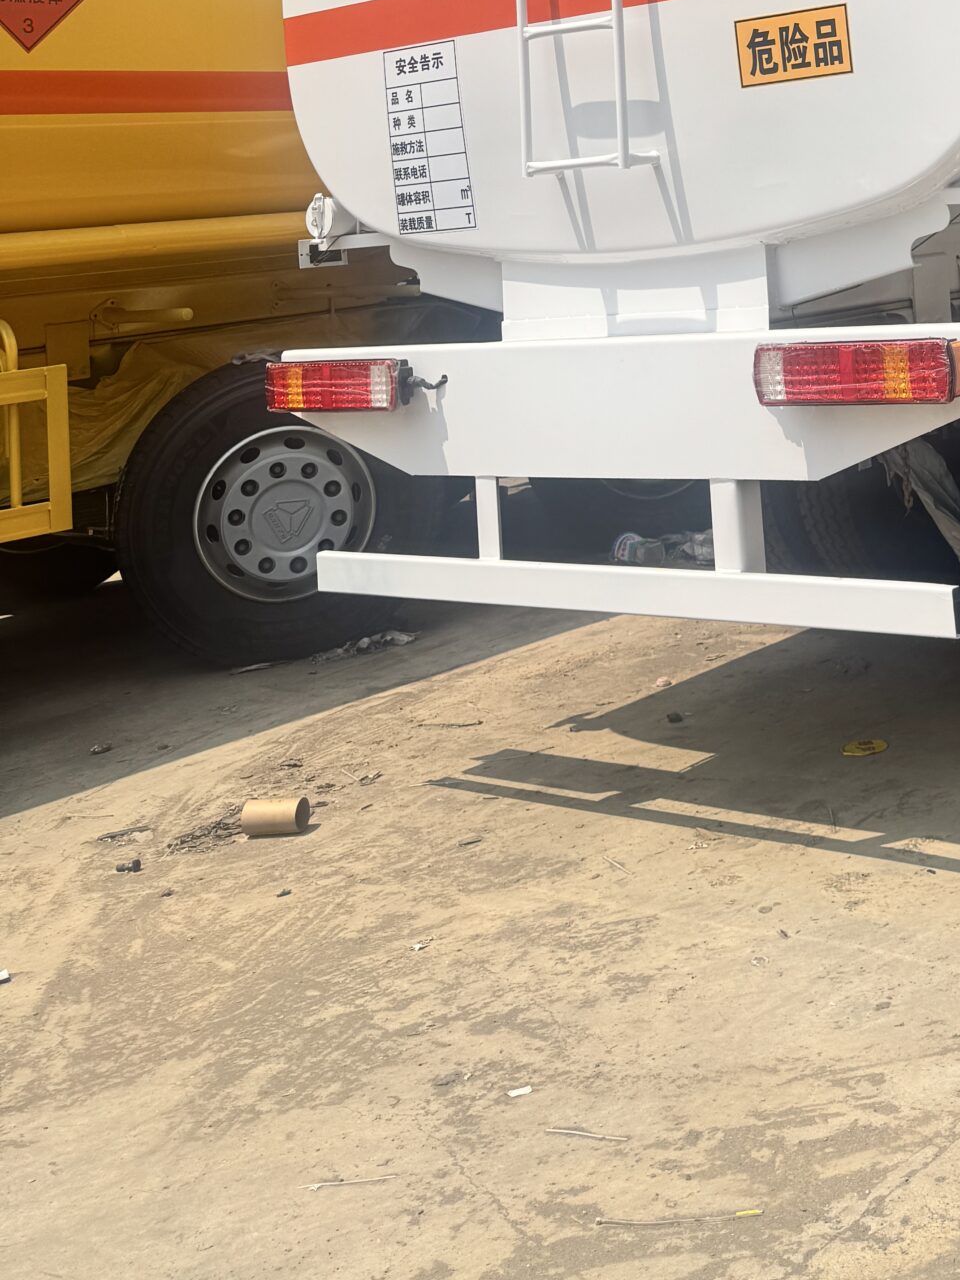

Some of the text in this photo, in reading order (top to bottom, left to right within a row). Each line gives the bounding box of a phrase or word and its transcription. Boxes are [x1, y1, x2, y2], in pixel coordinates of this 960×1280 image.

[23, 17, 34, 34] 3
[747, 18, 844, 77] 危险品
[395, 51, 444, 76] 安全告示
[391, 138, 425, 156] 施救方法
[394, 164, 428, 182] 联系电话
[397, 190, 431, 207] 罐体容积
[400, 215, 434, 232] 装载质量
[465, 212, 472, 225] T
